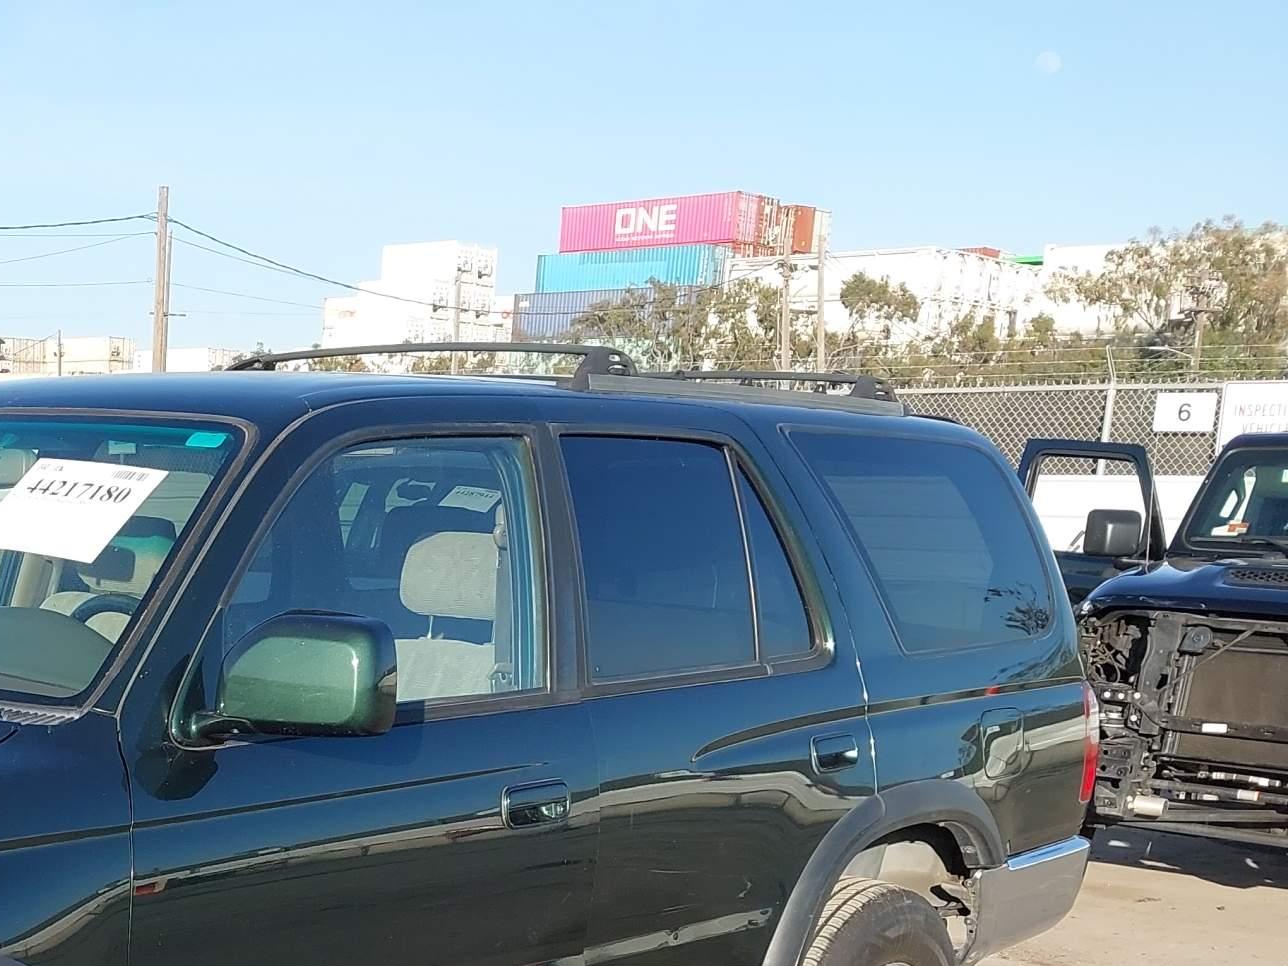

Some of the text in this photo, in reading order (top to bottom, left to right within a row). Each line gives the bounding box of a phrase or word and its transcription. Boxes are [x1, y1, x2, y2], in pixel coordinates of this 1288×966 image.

[615, 204, 678, 233] ONE
[1178, 403, 1192, 421] 6
[27, 478, 132, 503] 44217180
